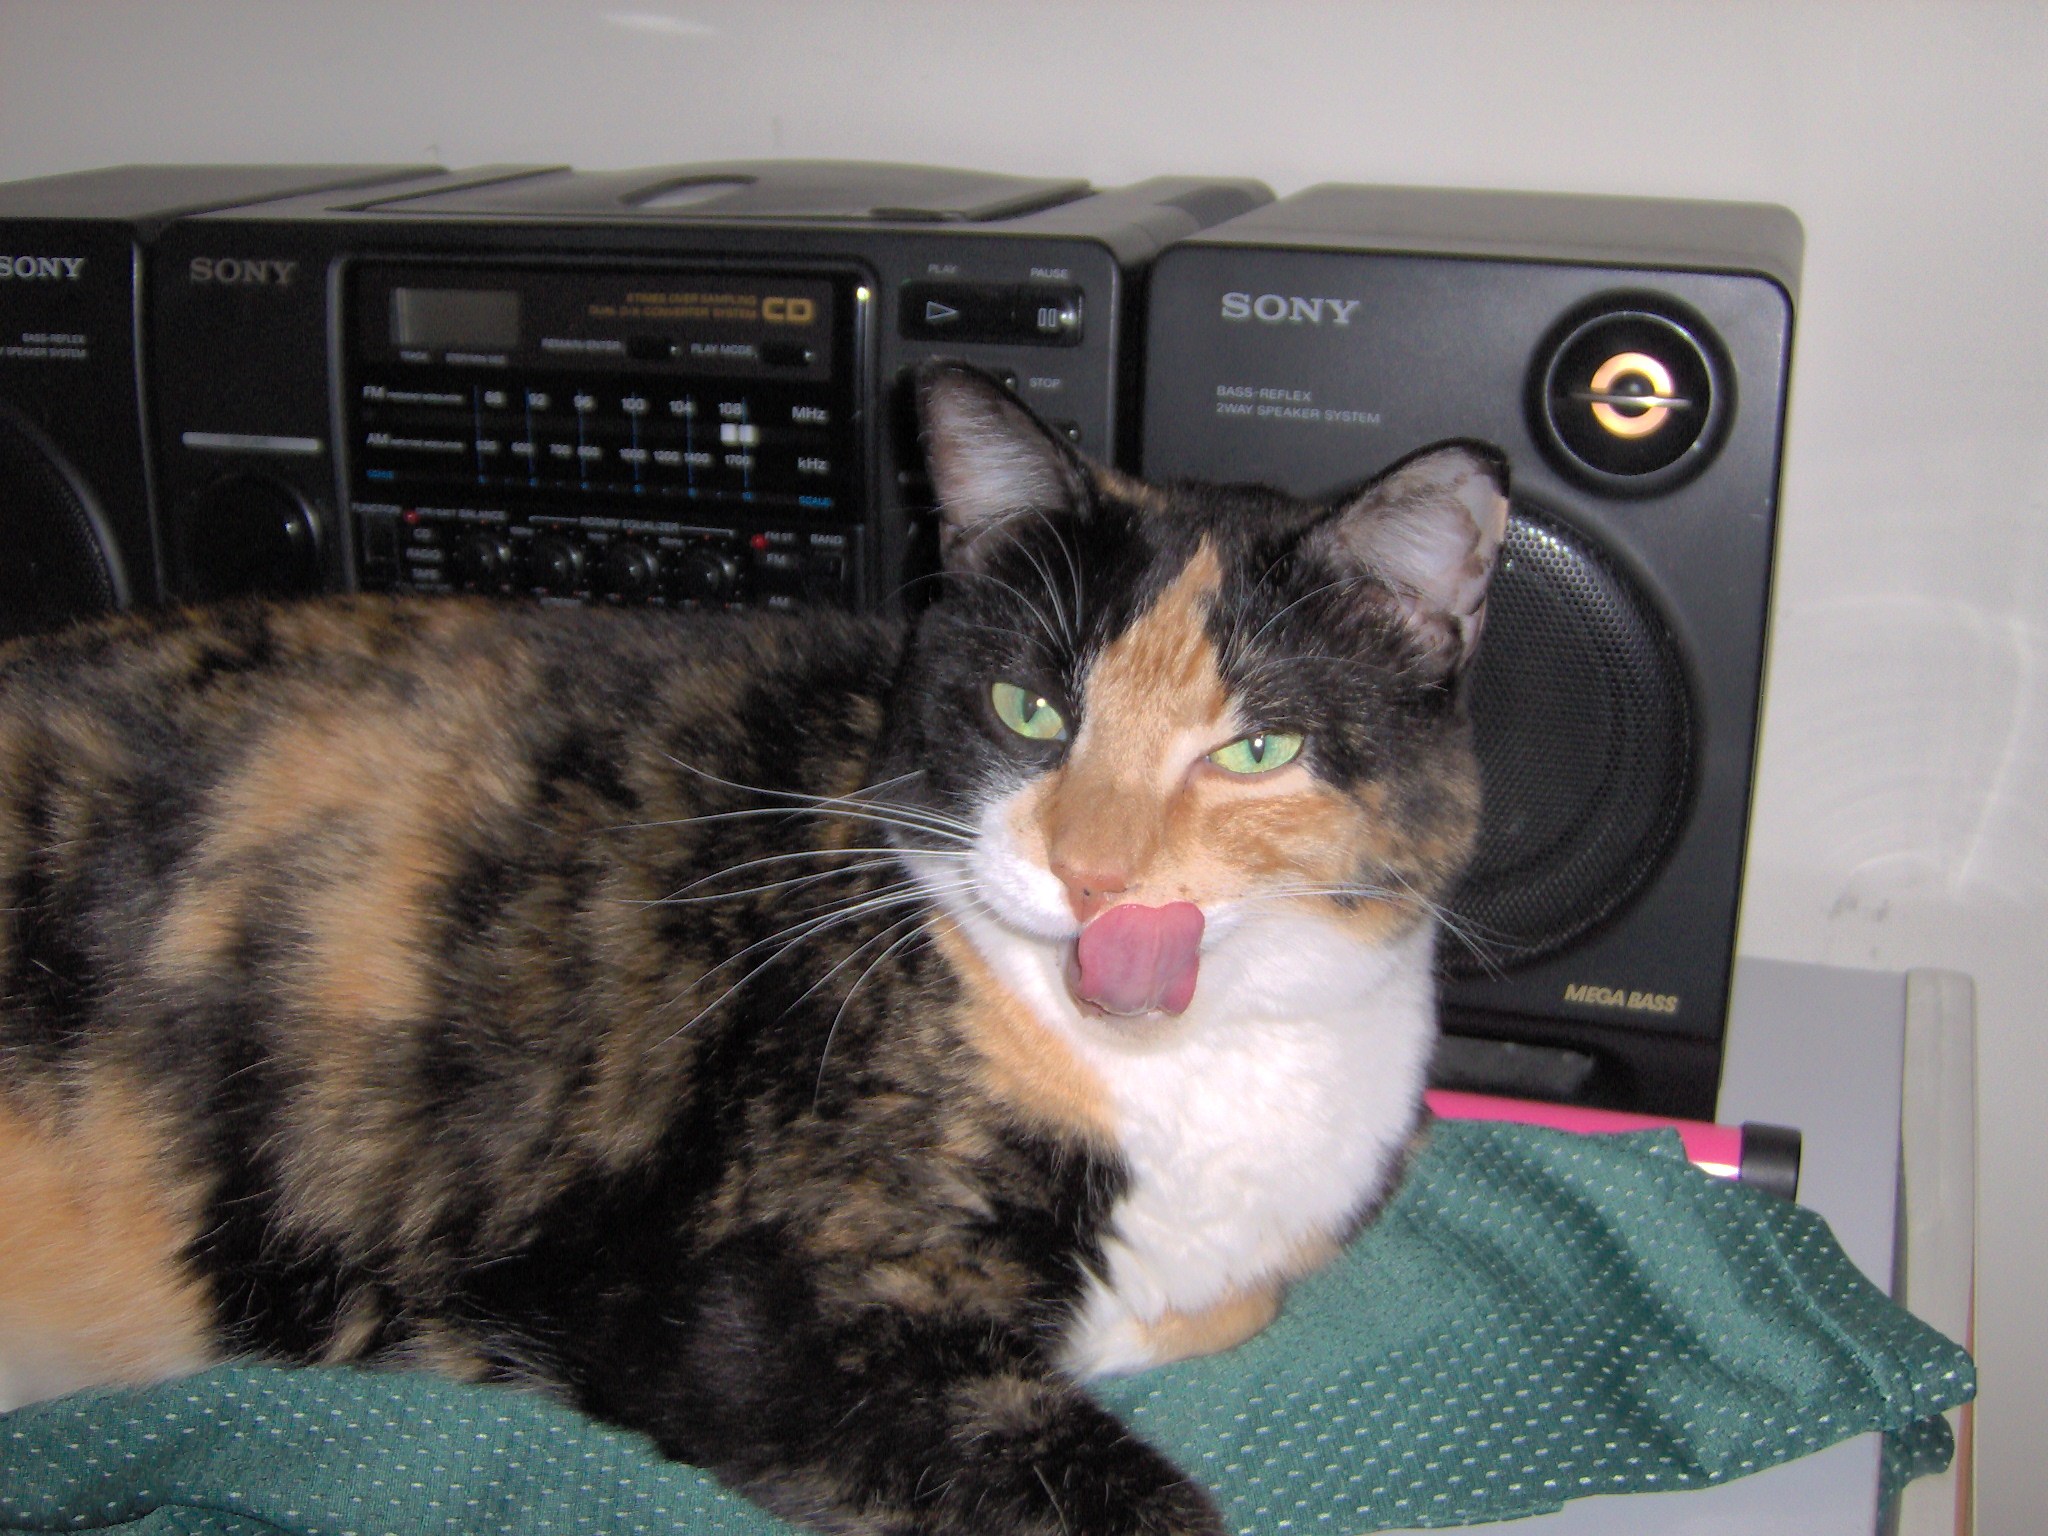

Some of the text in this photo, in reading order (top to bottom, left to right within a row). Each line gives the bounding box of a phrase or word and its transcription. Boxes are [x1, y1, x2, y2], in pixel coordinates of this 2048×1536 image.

[190, 256, 297, 286] SONY
[928, 264, 958, 275] PLAY
[1030, 267, 1069, 280] PAUSE
[762, 296, 814, 322] CD
[1221, 291, 1360, 325] SONY
[1029, 377, 1061, 388] STOP
[1216, 384, 1312, 402] BASS-REFLEX
[792, 406, 827, 421] MHz
[1216, 402, 1381, 424] 2WAY SPEAKER SYSTEM
[798, 458, 826, 470] kHz
[810, 534, 843, 545] BAND
[1564, 983, 1679, 1013] MEGA BASS
